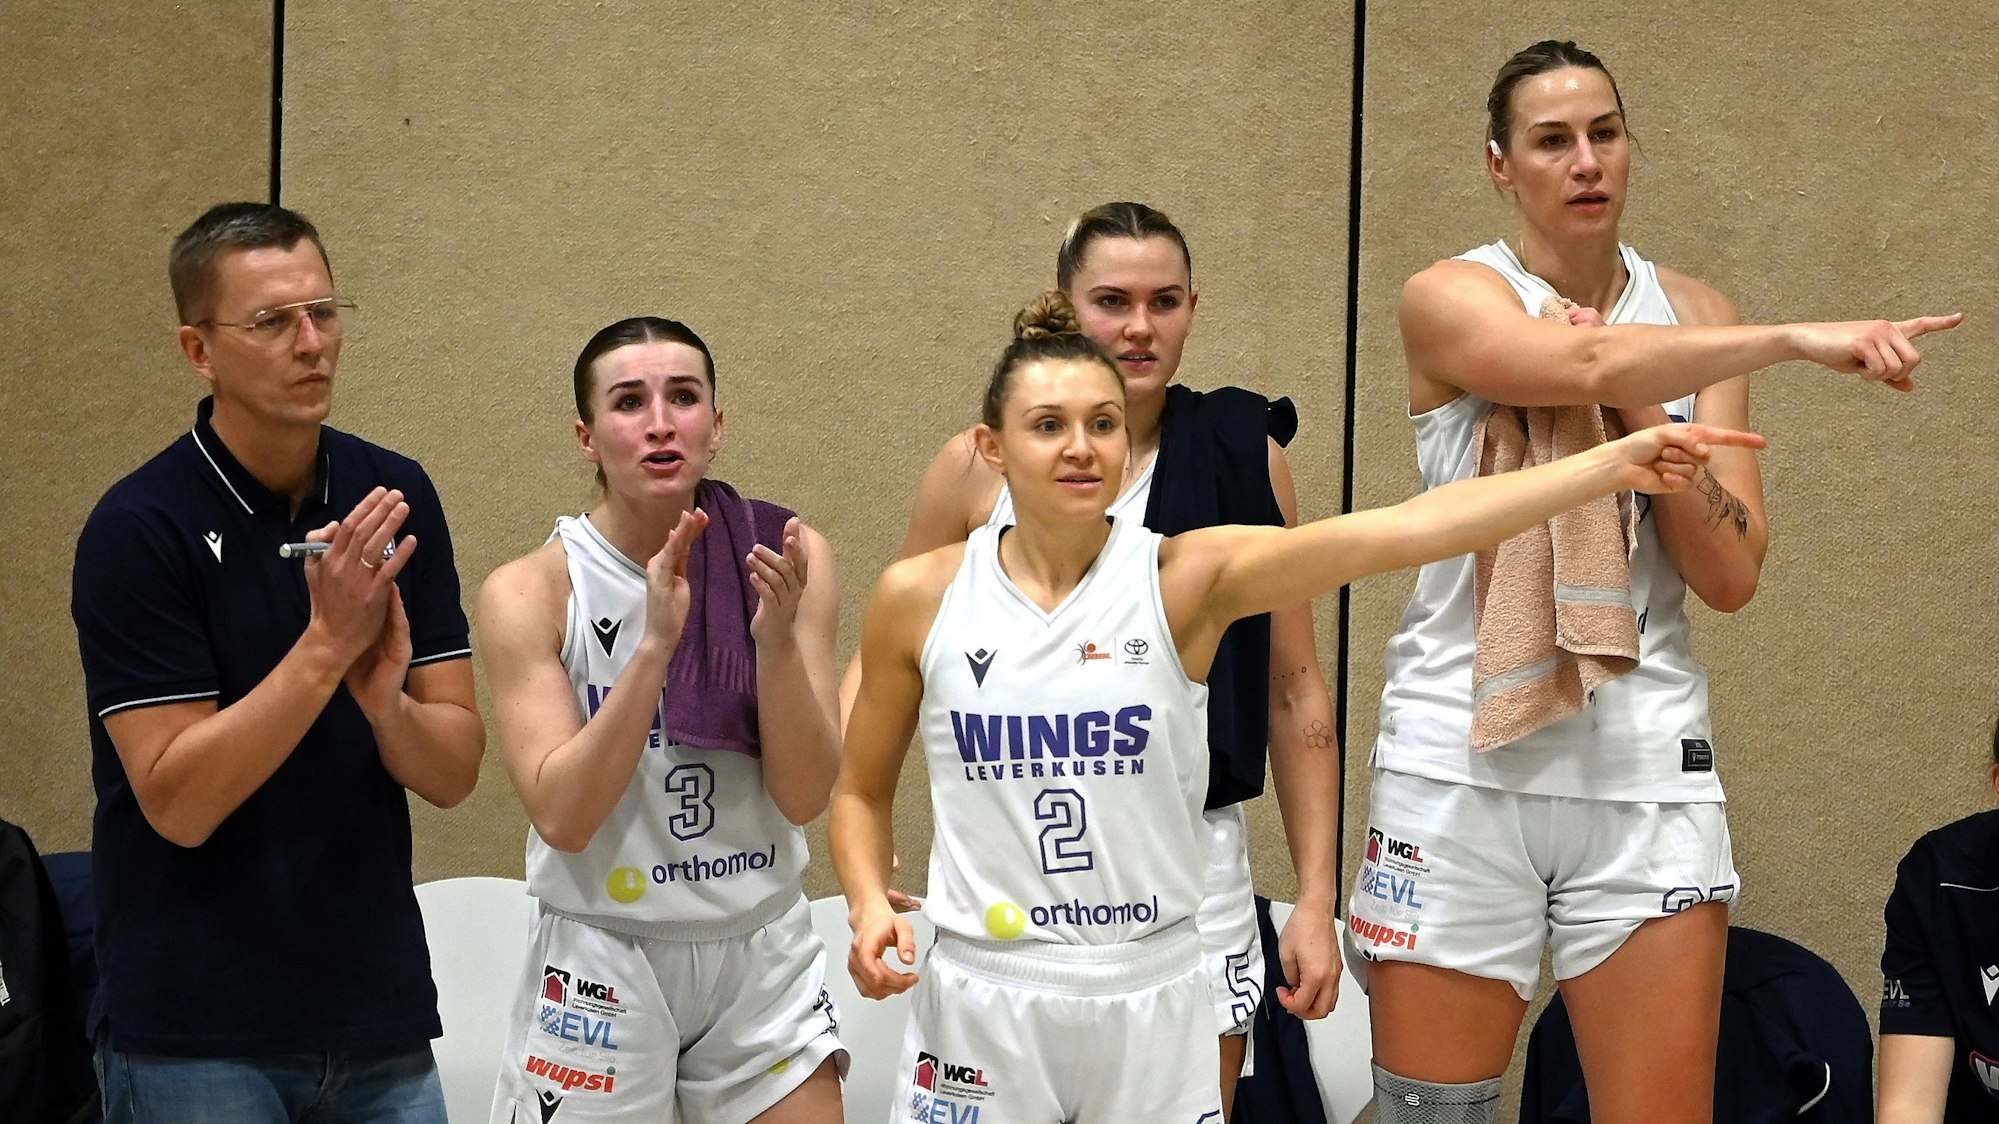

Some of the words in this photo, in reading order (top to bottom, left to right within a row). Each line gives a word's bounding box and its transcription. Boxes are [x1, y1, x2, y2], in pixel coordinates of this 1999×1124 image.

[950, 704, 1152, 763] WINGS
[965, 759, 1145, 781] LEVERKUSEN
[665, 762, 715, 842] 3
[1034, 788, 1094, 875] 2
[1388, 838, 1424, 863] WGL
[651, 843, 777, 886] orthomol
[1373, 871, 1422, 909] EVL
[1030, 895, 1159, 927] orthomol
[1350, 914, 1420, 950] wupsi
[577, 978, 619, 1004] WGL
[560, 1011, 618, 1050] EVL
[526, 1055, 616, 1093] wupsi
[944, 1063, 988, 1087] WGL
